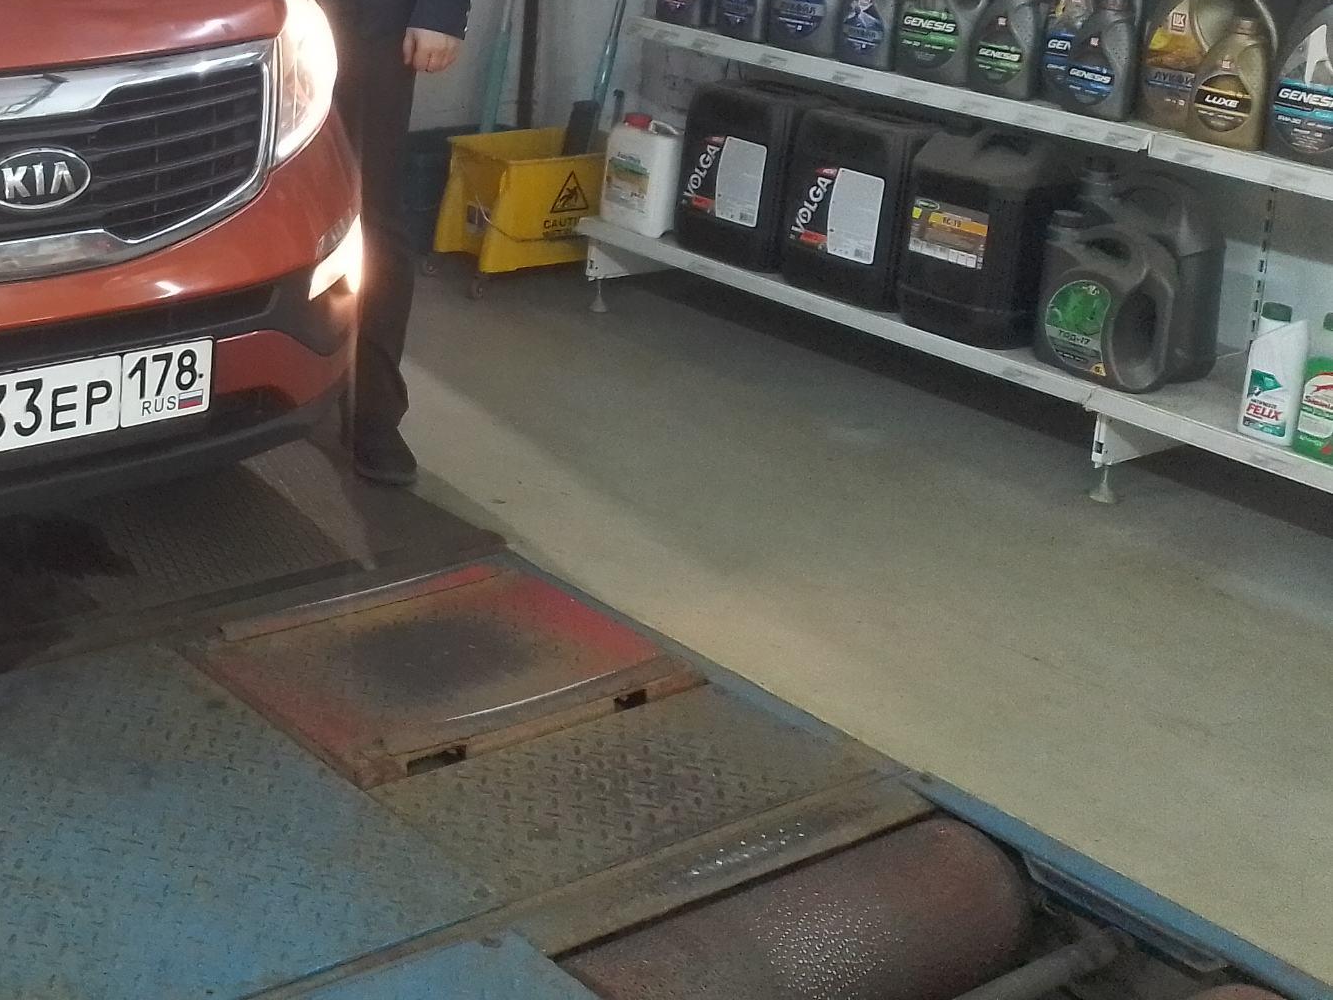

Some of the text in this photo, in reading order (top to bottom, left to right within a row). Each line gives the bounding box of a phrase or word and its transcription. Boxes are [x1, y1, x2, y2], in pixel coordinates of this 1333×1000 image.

[904, 15, 957, 33] GENESIS
[978, 47, 1021, 62] GENESIS
[1069, 68, 1112, 84] GENESIS
[1204, 94, 1240, 109] LUXE
[683, 143, 721, 198] VOLGA
[1, 161, 76, 199] KIA
[791, 175, 833, 233] VOLGA
[543, 216, 581, 229] CAUTI
[128, 349, 198, 400] 178
[142, 395, 177, 416] RUS
[1247, 402, 1283, 420] FELIX
